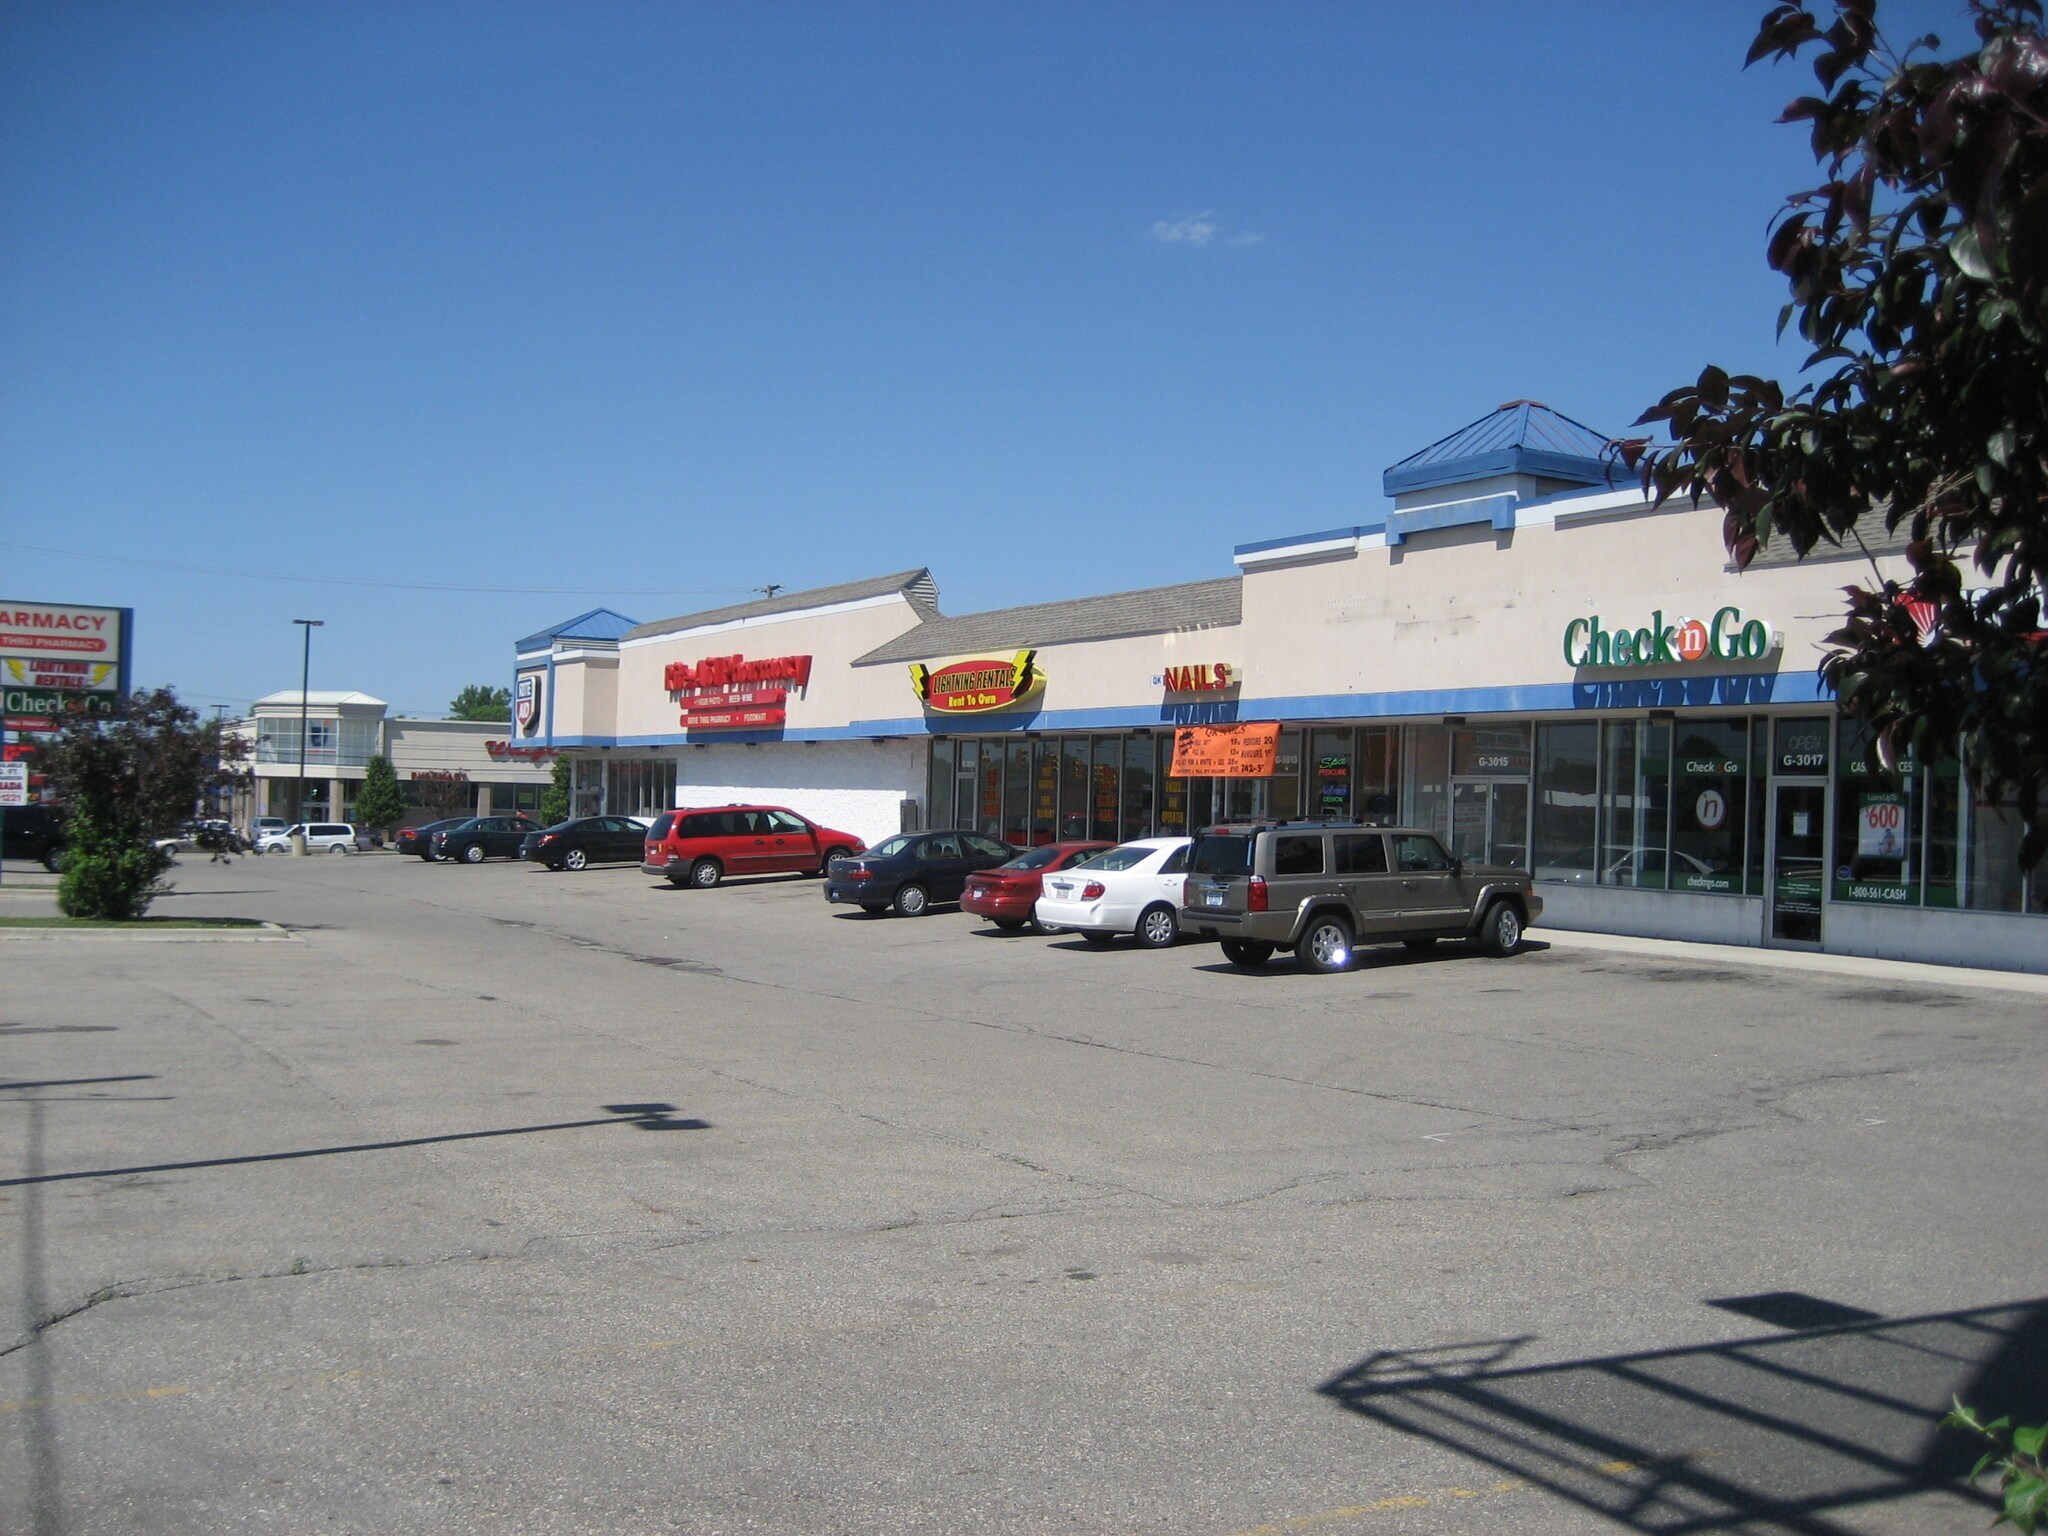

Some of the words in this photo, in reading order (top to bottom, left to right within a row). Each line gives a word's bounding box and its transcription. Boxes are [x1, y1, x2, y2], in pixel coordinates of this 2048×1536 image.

[2, 636, 33, 646] THRU
[36, 638, 101, 650] PHARMACY
[1563, 610, 1677, 668] Check
[1710, 606, 1768, 661] Go
[932, 671, 975, 695] LIGHTNING
[976, 667, 1017, 690] RENTALS
[1165, 663, 1226, 692] NAILS
[948, 696, 965, 708] Rent
[967, 694, 977, 706] To
[978, 693, 997, 705] Own
[1319, 756, 1348, 769] Spa
[1478, 756, 1509, 767] G-3015
[1686, 761, 1715, 773] Check
[1723, 761, 1739, 773] Go
[1783, 753, 1824, 767] G-3017
[1848, 886, 1907, 901] 1-800-561-CASH
